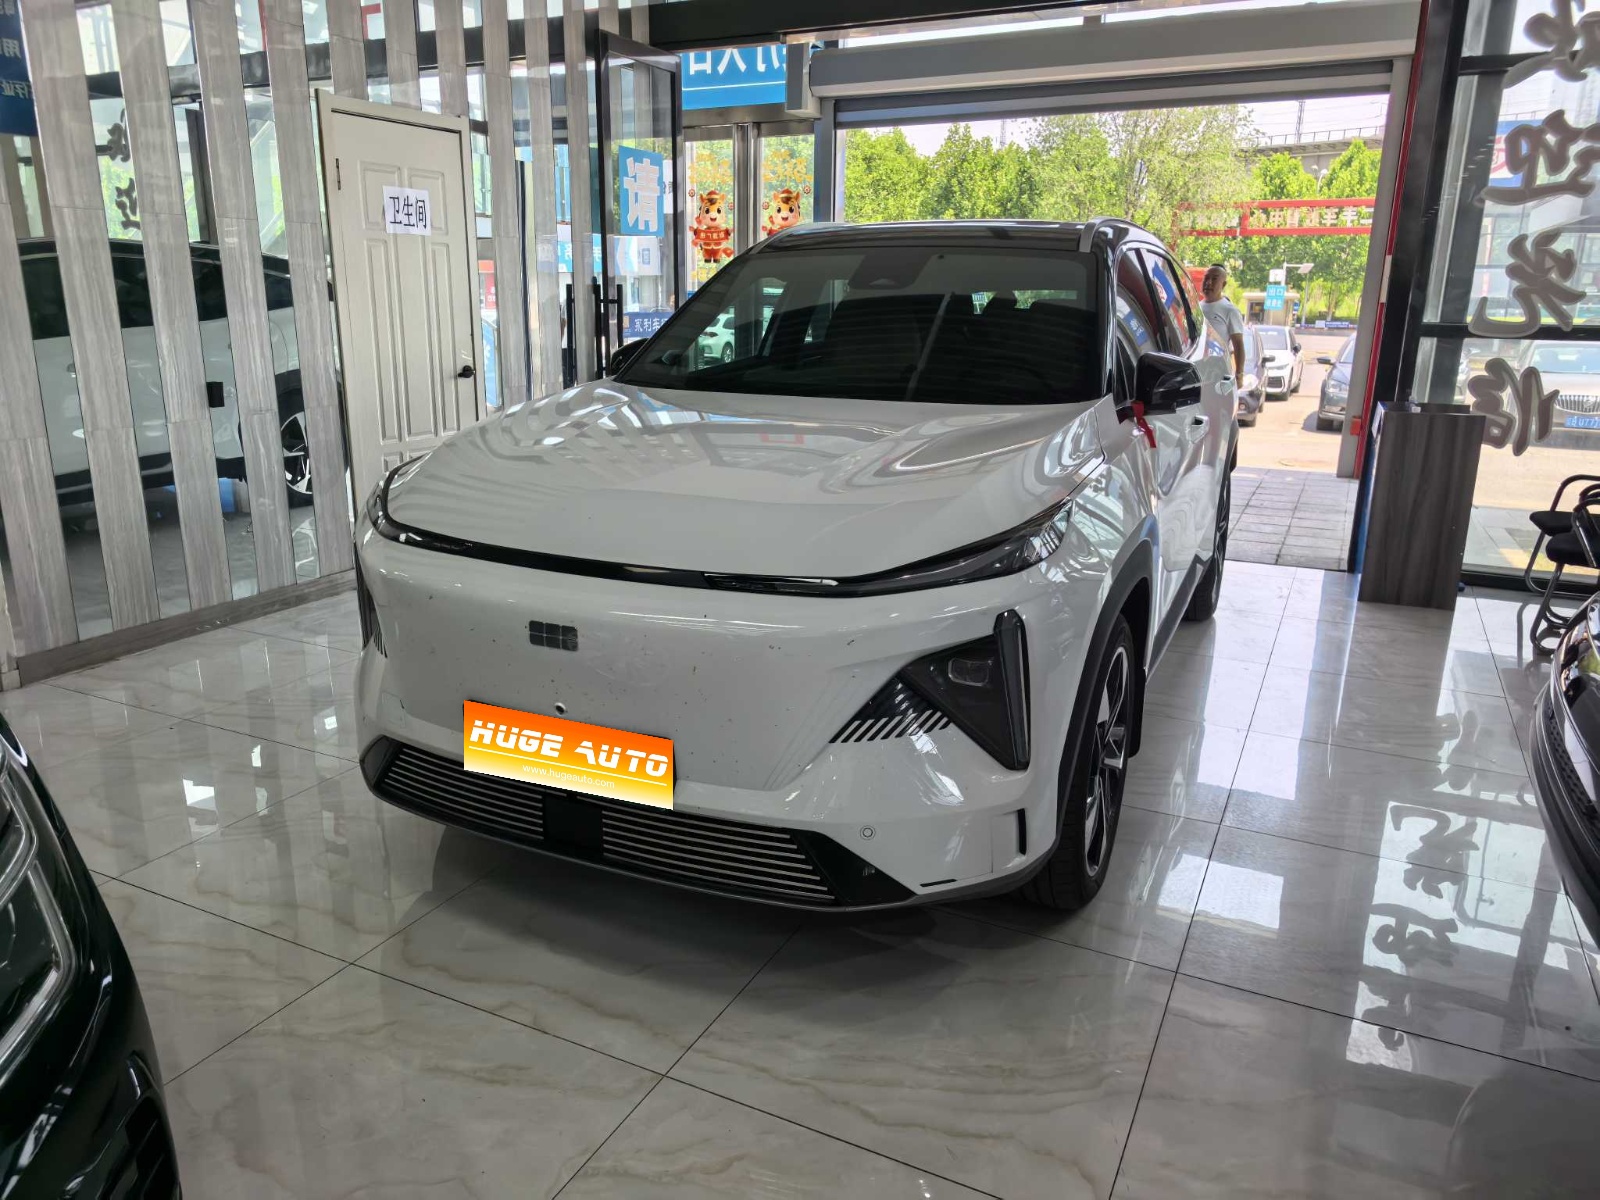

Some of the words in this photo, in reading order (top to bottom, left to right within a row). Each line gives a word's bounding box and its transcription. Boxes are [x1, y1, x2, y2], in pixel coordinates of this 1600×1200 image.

[389, 195, 427, 229] 卫生间
[623, 157, 660, 232] 请
